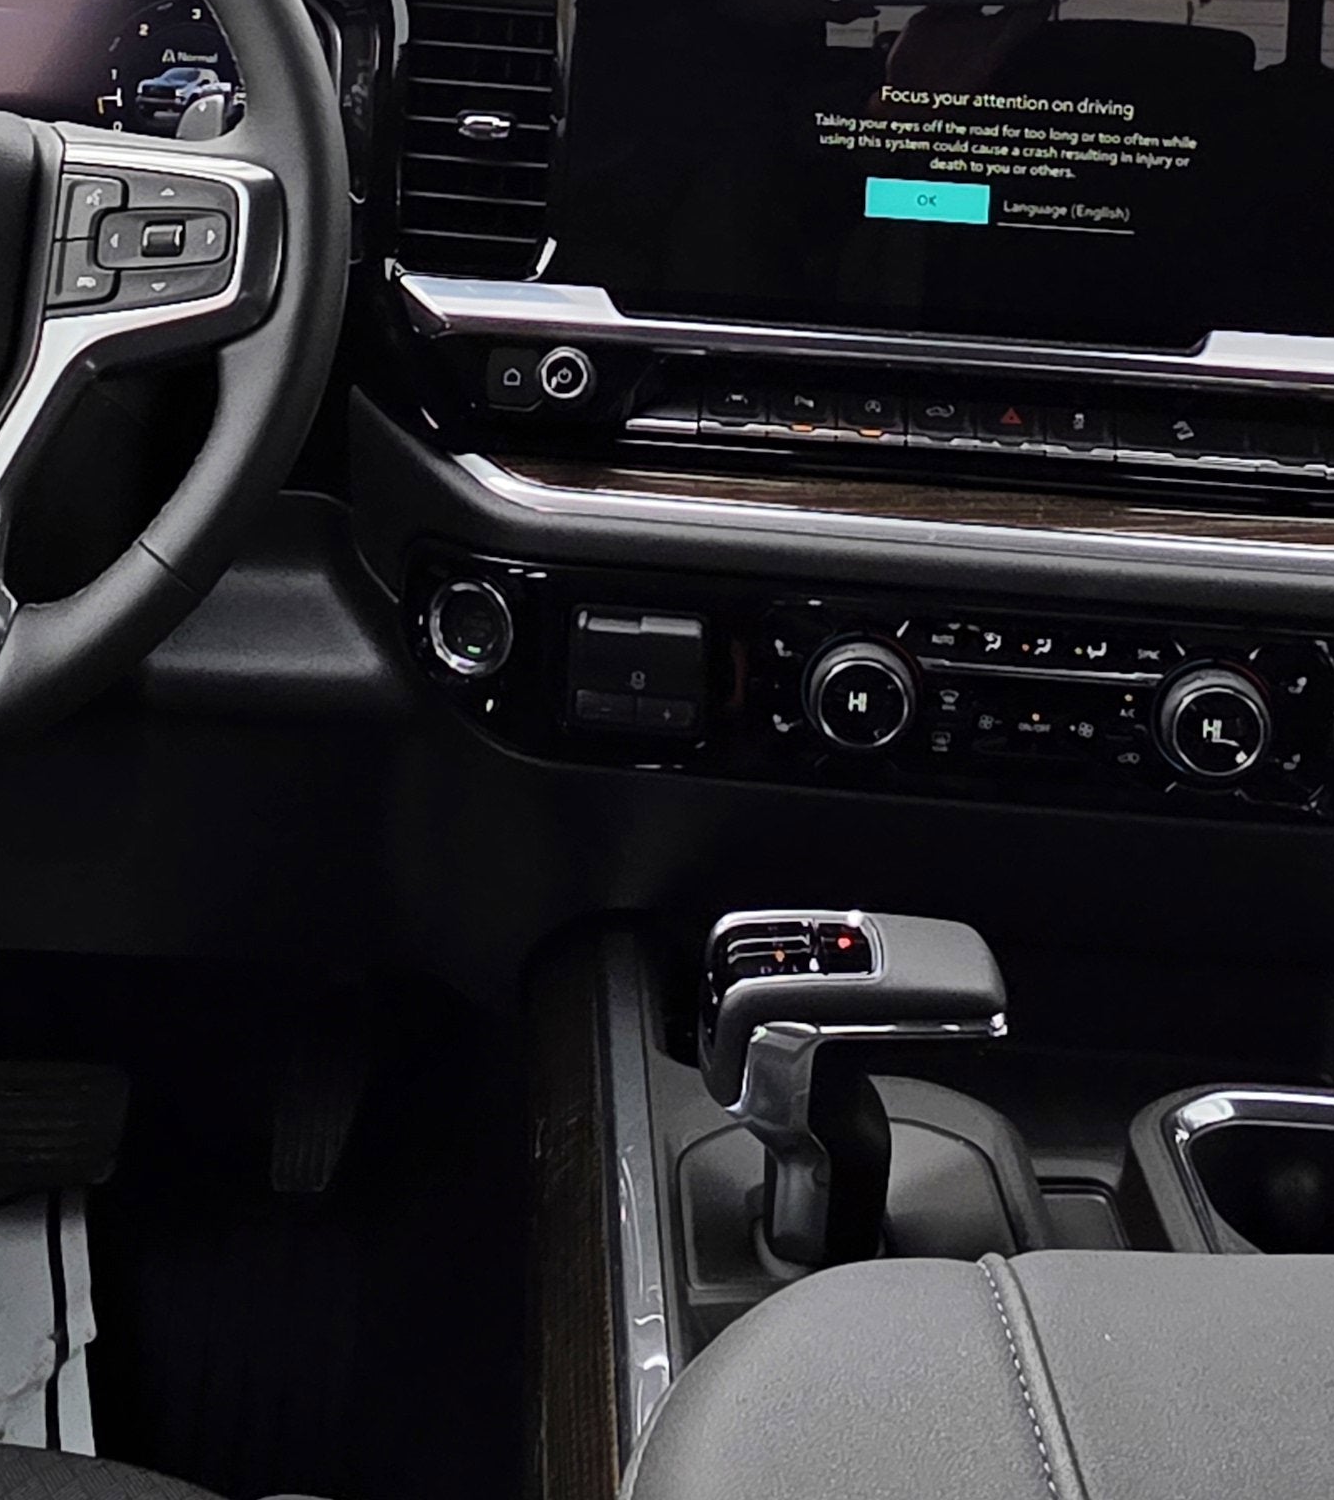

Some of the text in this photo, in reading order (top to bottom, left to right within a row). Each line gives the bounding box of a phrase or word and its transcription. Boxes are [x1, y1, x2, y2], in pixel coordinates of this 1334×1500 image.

[192, 9, 202, 20] 3
[139, 24, 149, 36] 2
[178, 51, 218, 63] Normal
[880, 84, 1135, 121] Focus your attention on driving
[813, 111, 1198, 149] Taking your eyes off the road for too long or too often while
[818, 132, 1190, 170] using this system could cause a crash resulting in injury or
[928, 156, 1076, 178] death to you or others.
[917, 194, 936, 207] OK
[1001, 200, 1130, 224] Language (English)
